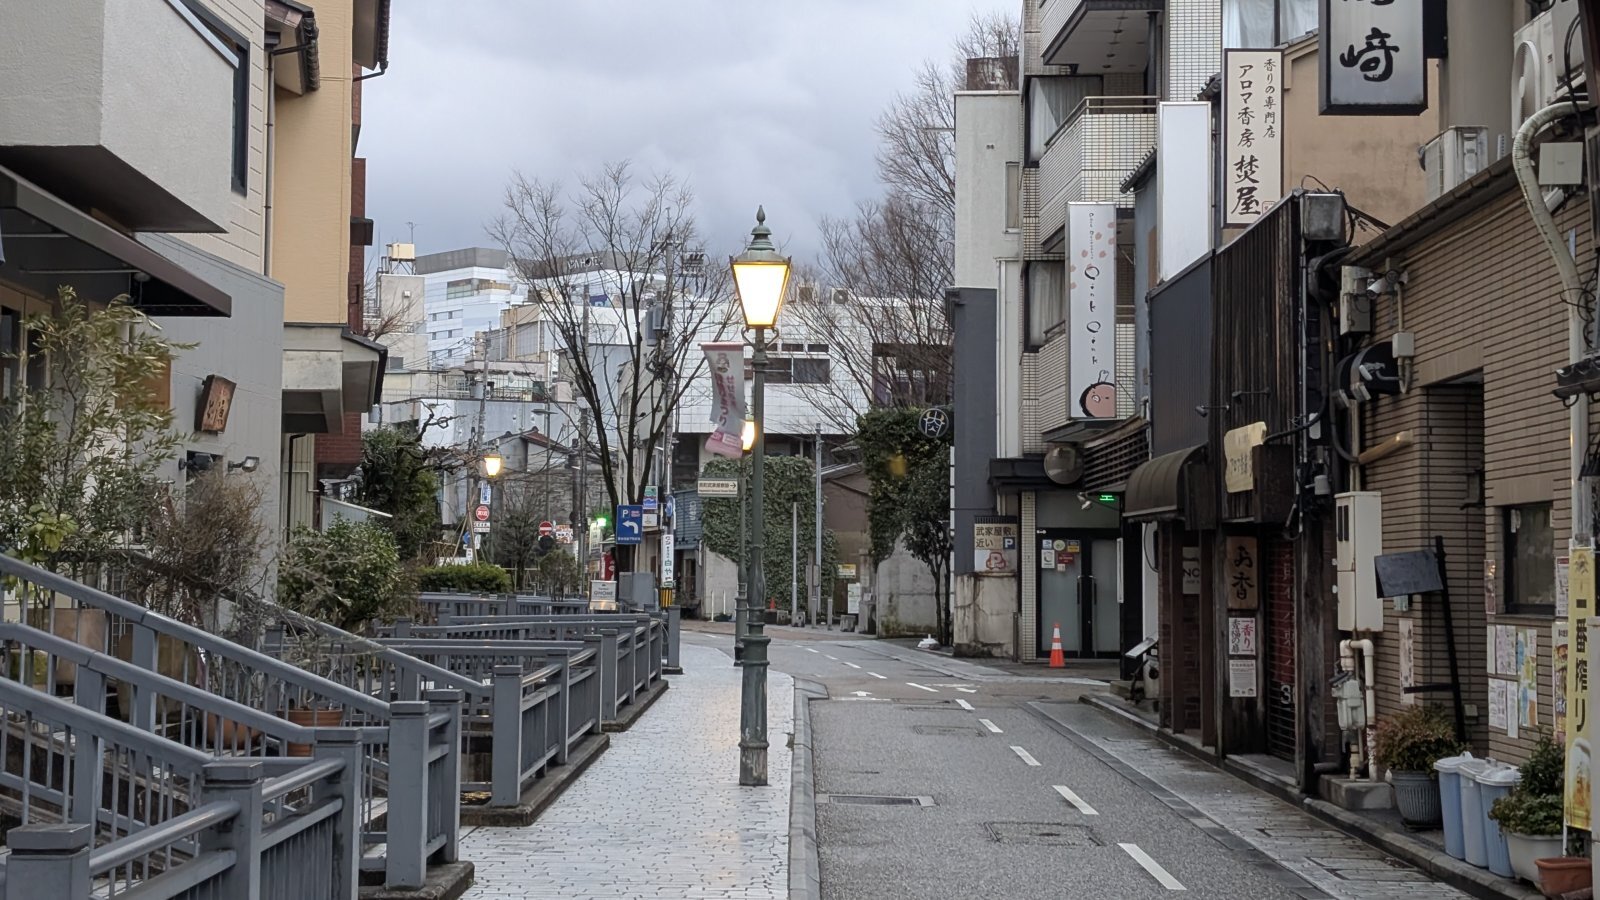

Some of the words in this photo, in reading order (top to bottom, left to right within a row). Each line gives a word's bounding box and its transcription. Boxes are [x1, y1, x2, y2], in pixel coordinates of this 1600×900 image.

[1237, 64, 1256, 148] アロマ香房
[1263, 58, 1277, 139] 香りの専門店
[1231, 154, 1262, 216] 焚屋
[622, 509, 629, 518] P
[976, 538, 993, 548] 近い
[1004, 538, 1014, 548] P
[1231, 545, 1255, 600] お香
